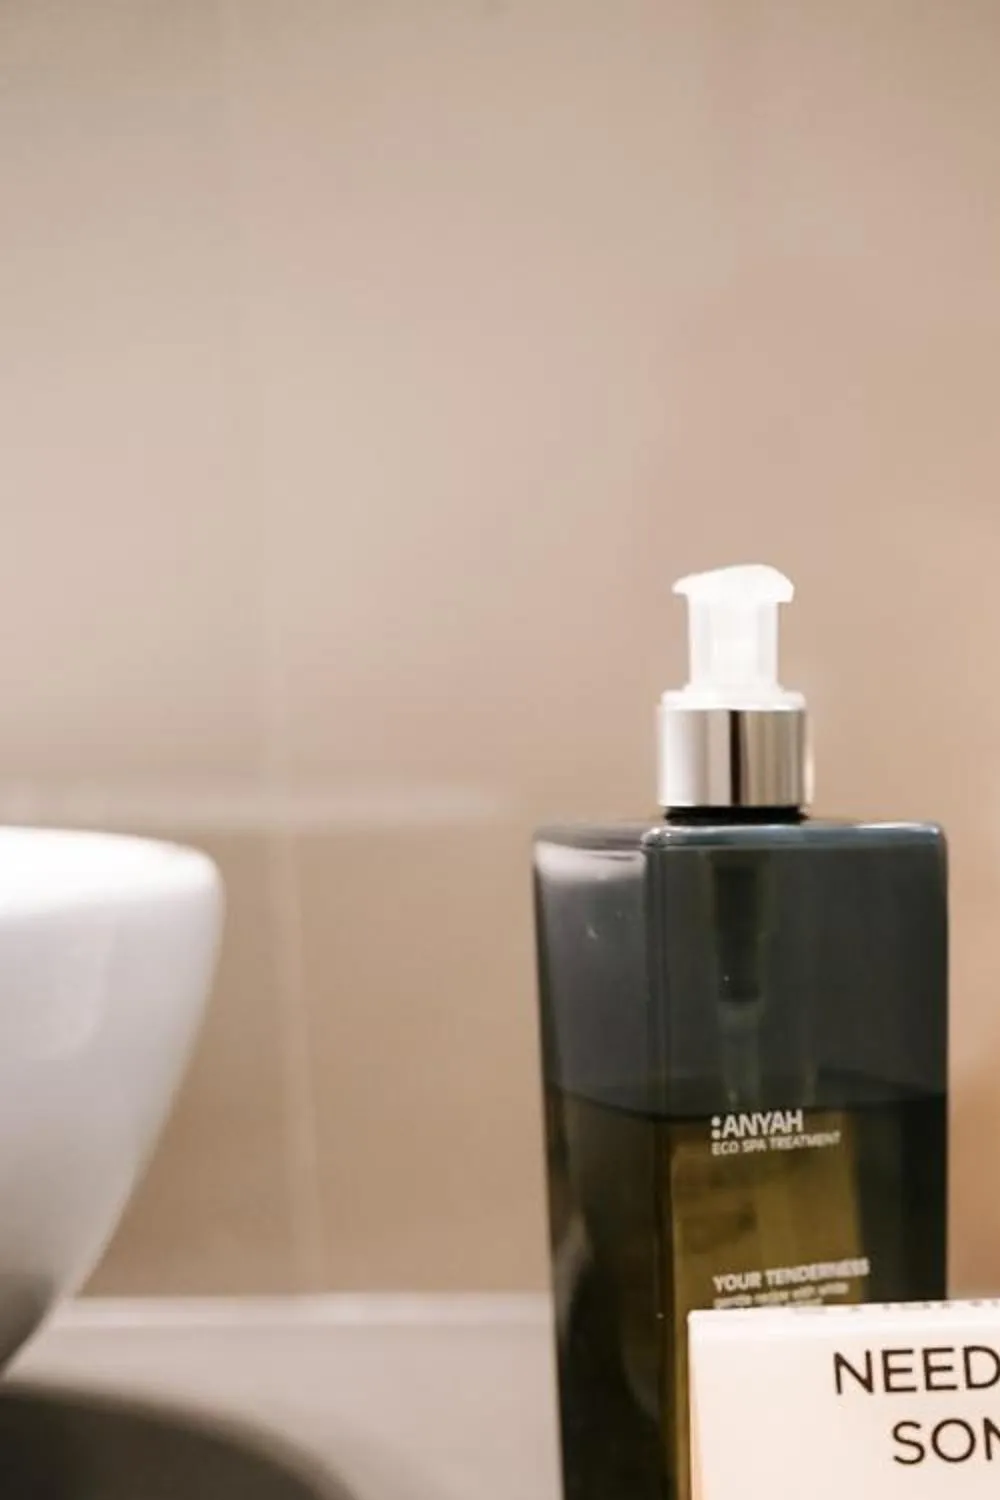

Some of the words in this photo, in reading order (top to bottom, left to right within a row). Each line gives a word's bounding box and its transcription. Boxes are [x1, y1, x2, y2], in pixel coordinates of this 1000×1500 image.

[711, 1139, 740, 1156] ECO
[742, 1137, 766, 1153] SPA
[770, 1130, 841, 1150] TREATMENT
[712, 1271, 761, 1293] YOUR
[765, 1257, 870, 1286] TENDERNESS
